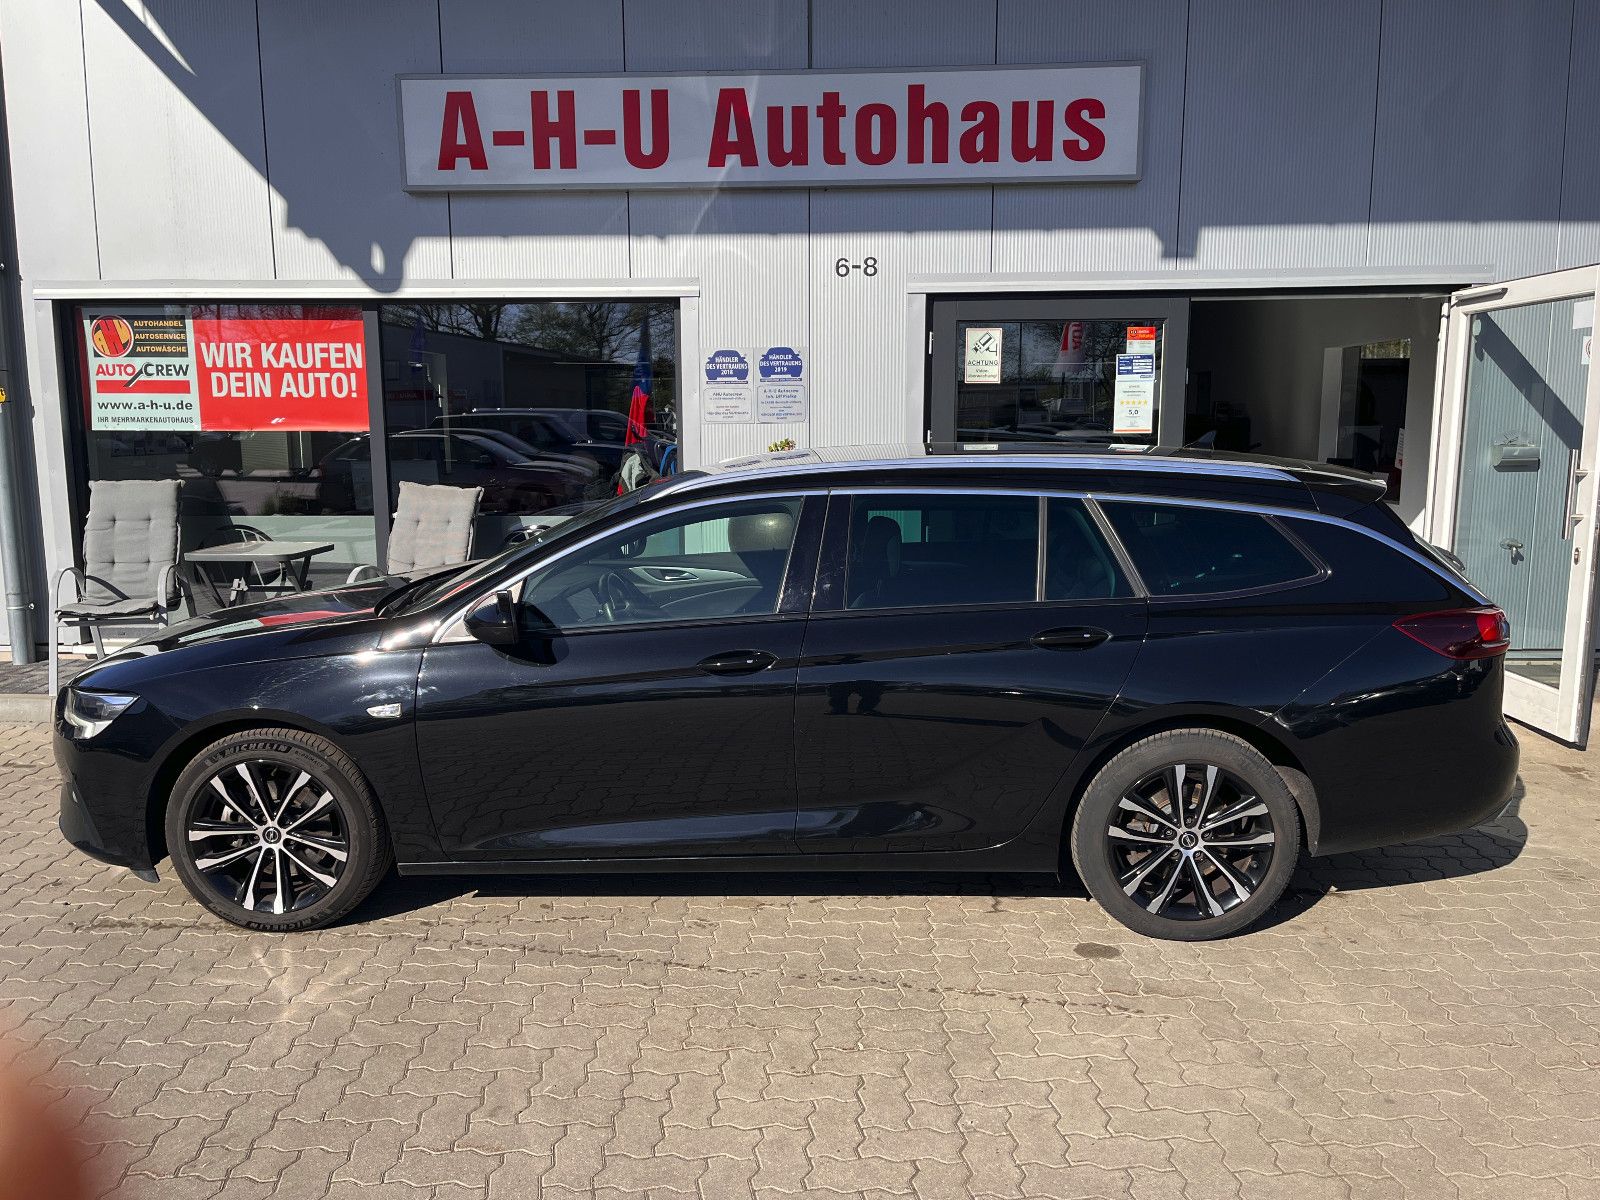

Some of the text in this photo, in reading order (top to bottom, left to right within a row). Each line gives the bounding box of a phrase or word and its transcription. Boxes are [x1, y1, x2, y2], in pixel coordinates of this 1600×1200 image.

[437, 83, 1107, 171] A-H-U Autohaus
[835, 256, 878, 278] 6-8
[135, 345, 187, 353] AUTOWÄSCHE
[199, 342, 363, 369] WIR KAUFEN
[95, 362, 190, 377] AUTO CREW
[210, 371, 358, 398] DEIN AUTO!
[97, 399, 193, 410] www.a-h-u.de
[111, 416, 194, 424] MEHRMARKENAUTOHAUS
[226, 742, 288, 756] MICHELIN
